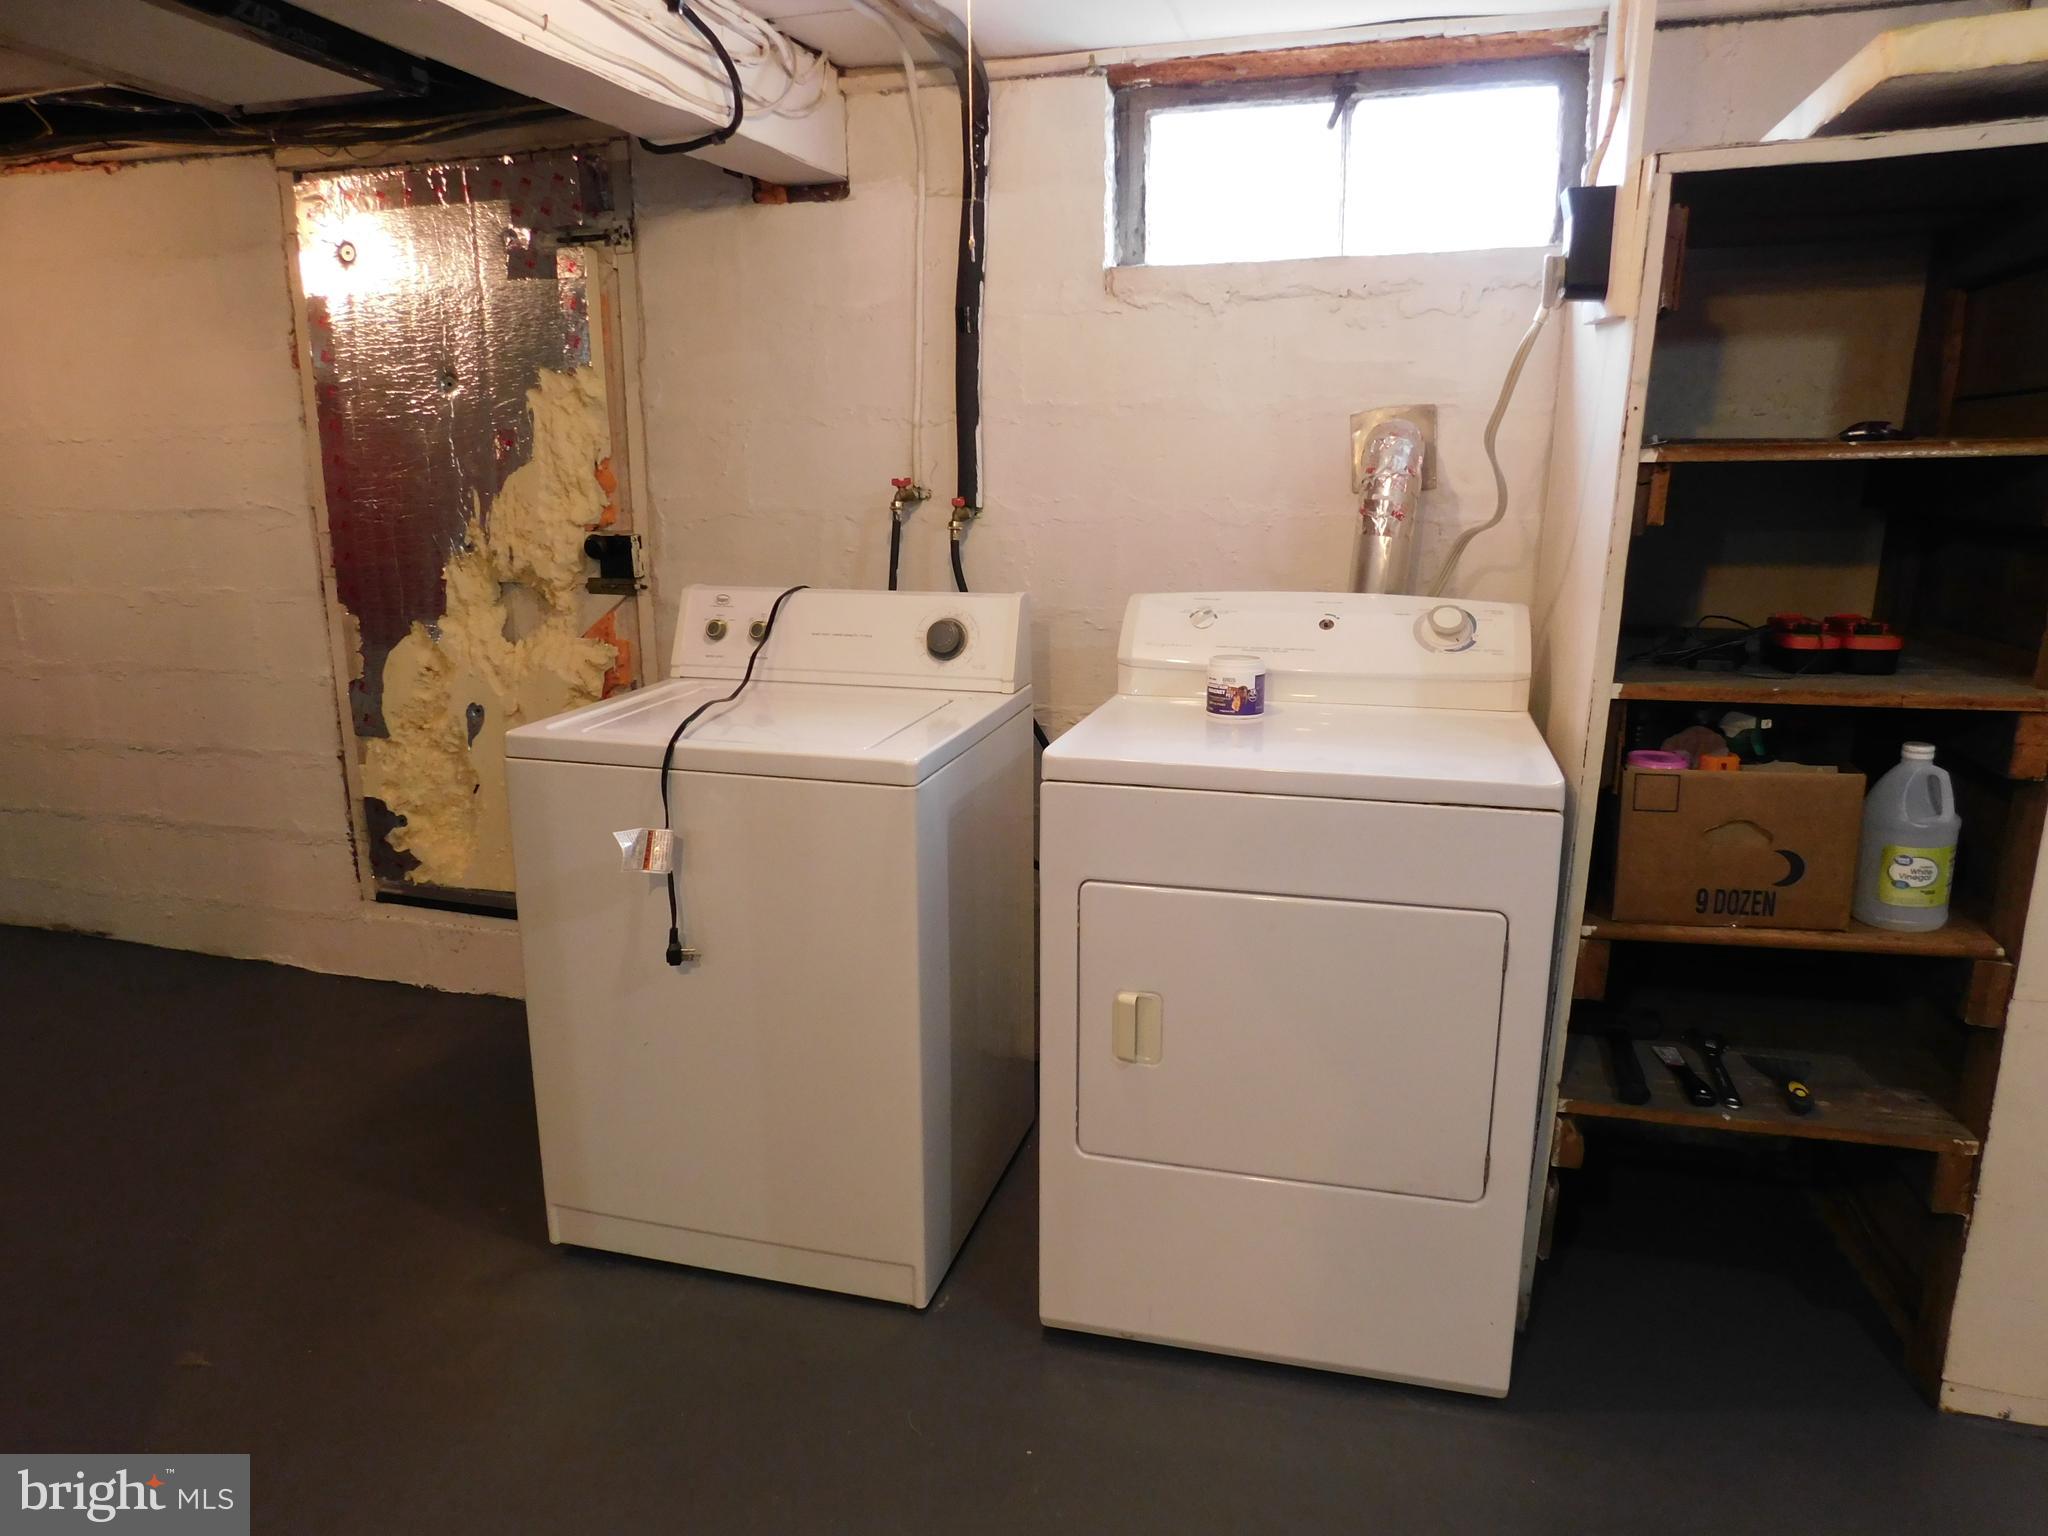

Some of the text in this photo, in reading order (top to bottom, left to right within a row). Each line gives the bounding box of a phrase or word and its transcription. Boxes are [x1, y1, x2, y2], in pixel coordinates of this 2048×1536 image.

[1898, 873, 1932, 882] Vinegar
[1696, 888, 1776, 917] 9 DOZEN
